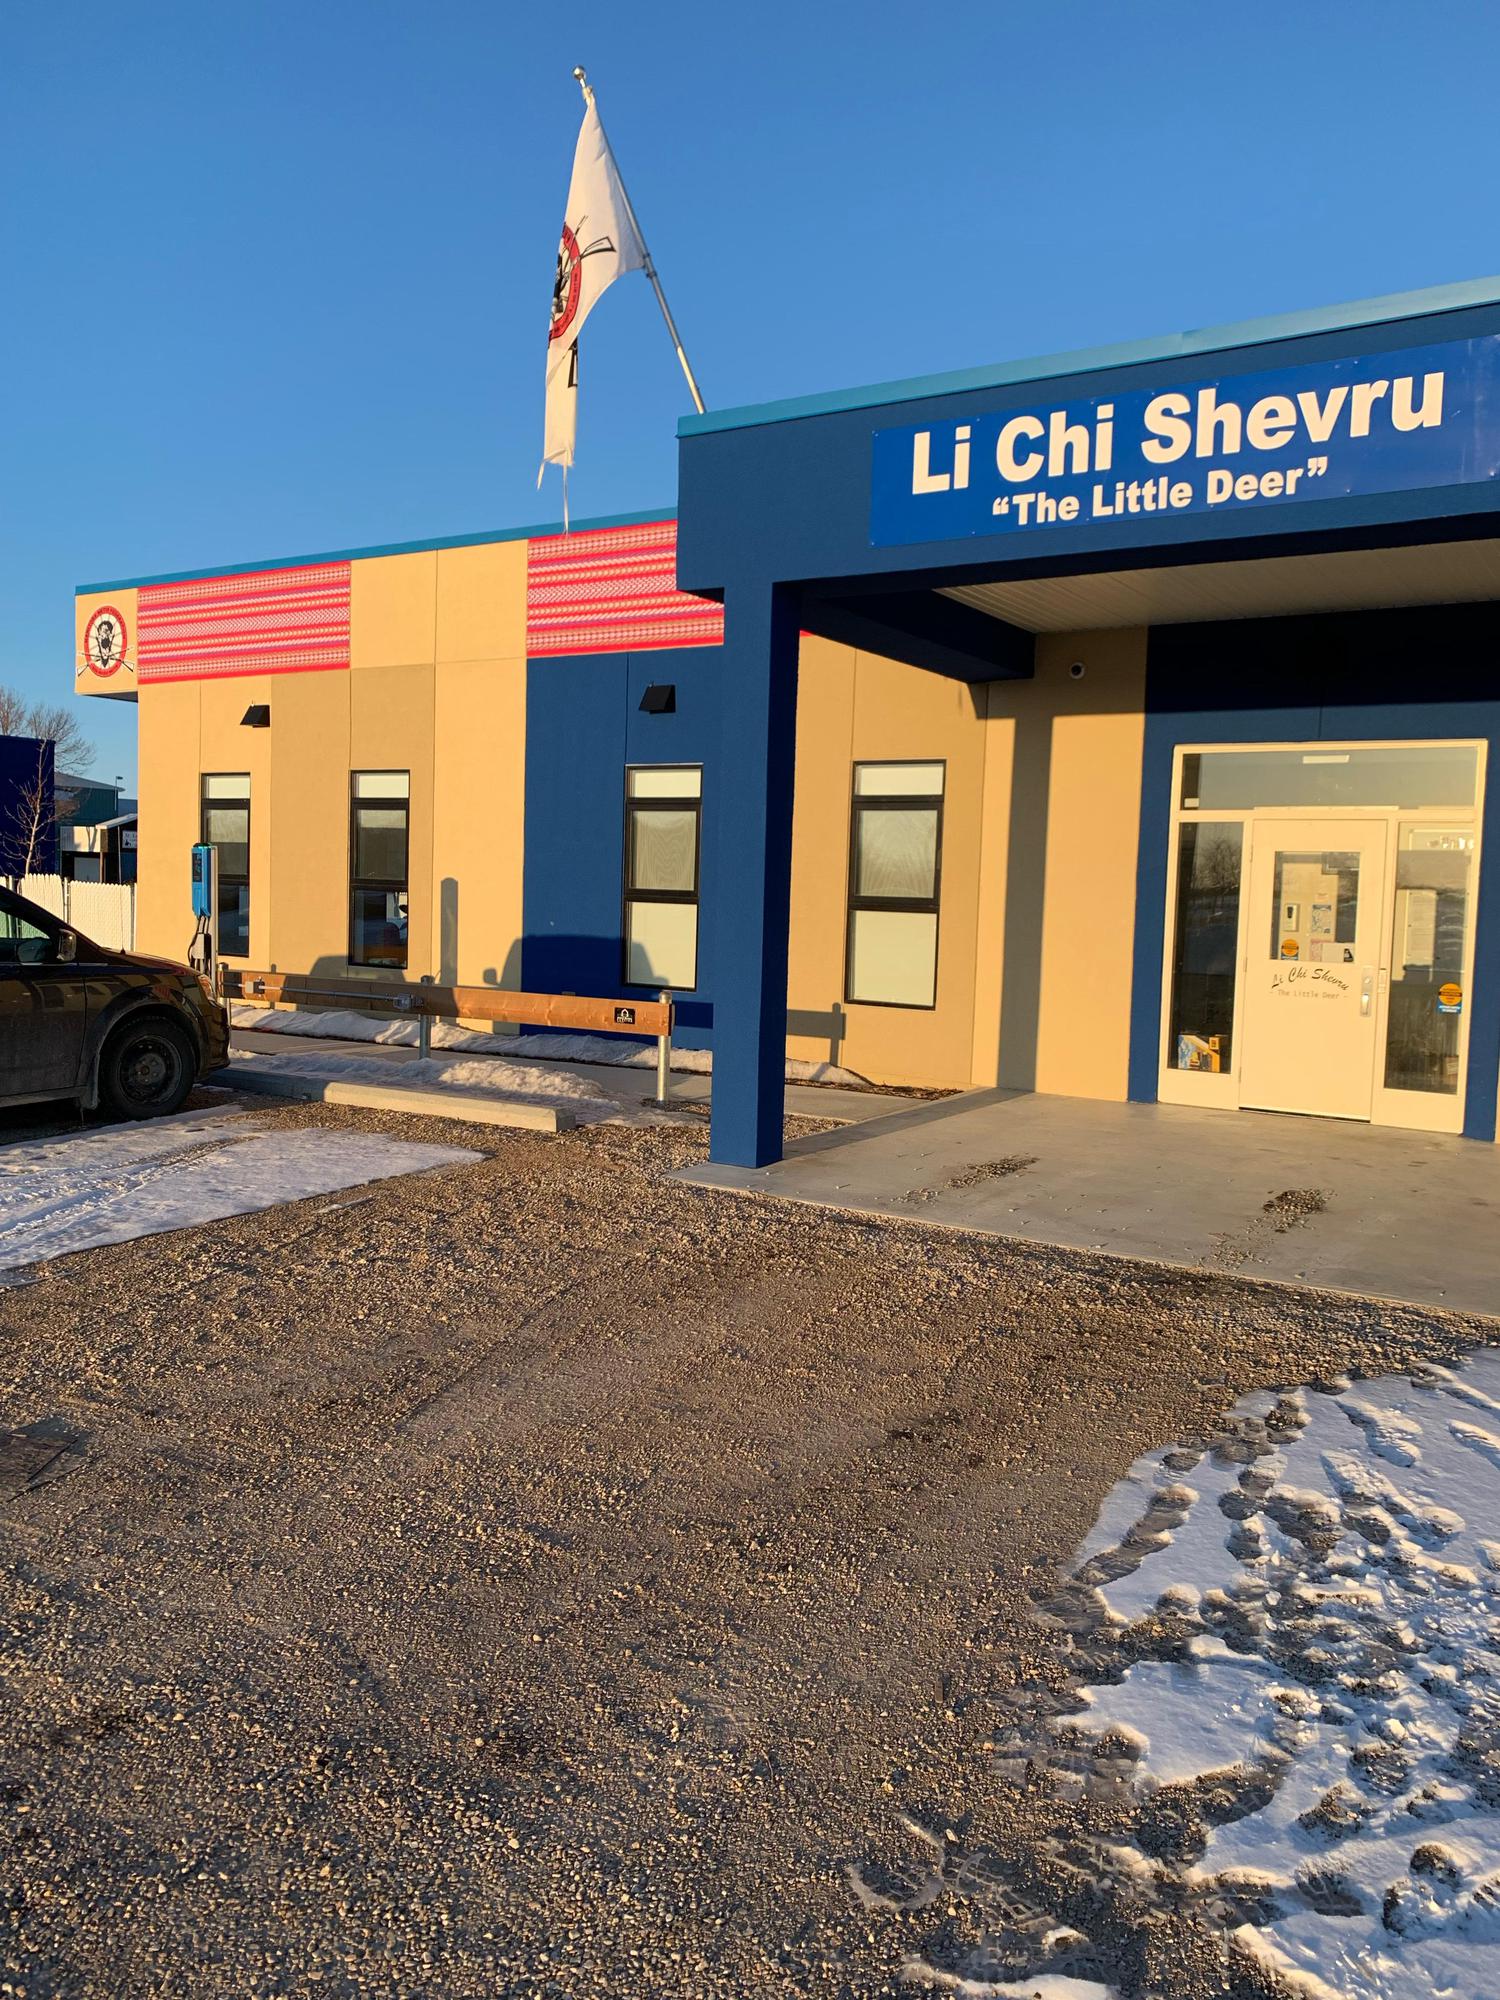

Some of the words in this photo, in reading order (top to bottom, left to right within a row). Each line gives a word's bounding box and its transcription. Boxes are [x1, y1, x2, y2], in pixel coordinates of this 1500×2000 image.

[912, 425, 971, 495] Li
[996, 403, 1114, 482] Chi
[1141, 371, 1445, 464] Shevru
[1092, 476, 1193, 517] Little
[1278, 989, 1290, 997] The
[1288, 967, 1308, 983] Chi
[1312, 968, 1350, 990] Shevru
